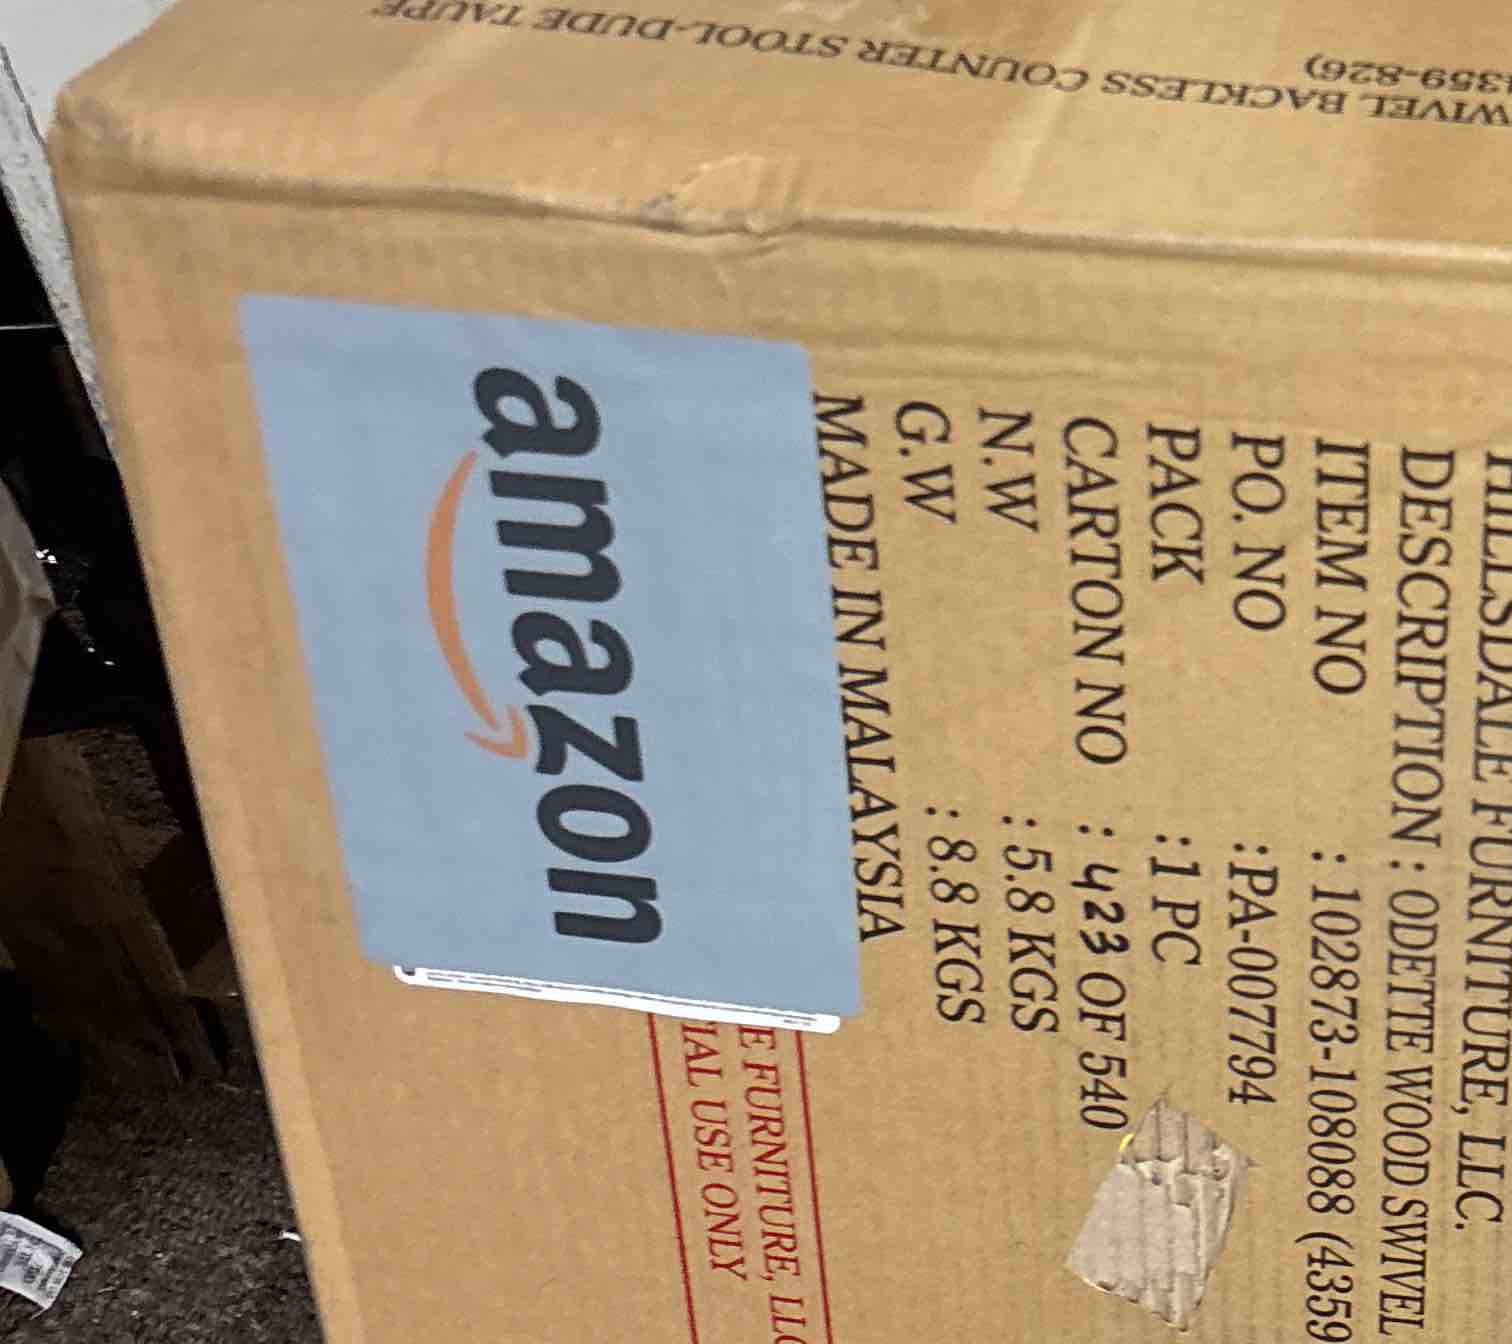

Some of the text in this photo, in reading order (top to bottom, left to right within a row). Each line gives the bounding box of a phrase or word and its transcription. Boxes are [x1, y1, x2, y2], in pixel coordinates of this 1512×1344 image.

[532, 7, 849, 58] STOOL-DUDE
[856, 39, 1090, 93] COUNTER
[1101, 71, 1347, 115] BACKLESS
[1315, 436, 1370, 591] ITEM
[471, 367, 664, 944] amazon
[811, 391, 905, 944] MADE IN MALAYSIA
[895, 400, 985, 1025] G.W 8.8 KGS
[977, 406, 1059, 1034] N.W 5.8 KGS
[1148, 421, 1204, 966] PACK 1 PC
[1313, 606, 1368, 695] NO
[1388, 446, 1455, 846] DESCRIPTION
[1063, 417, 1128, 1131] CARTON NO 423 OF 540
[1228, 431, 1288, 1105] PO. NO PA-007794
[1305, 884, 1362, 1214] 102873-108088
[1384, 889, 1438, 1052] ODETTE
[690, 1099, 736, 1174] USE
[741, 1059, 801, 1282] FURNITURE,
[1381, 1064, 1434, 1186] WOOD
[1455, 1131, 1506, 1231] LLC.
[701, 1182, 748, 1281] ONLY
[1377, 1195, 1429, 1336] SWIVEL
